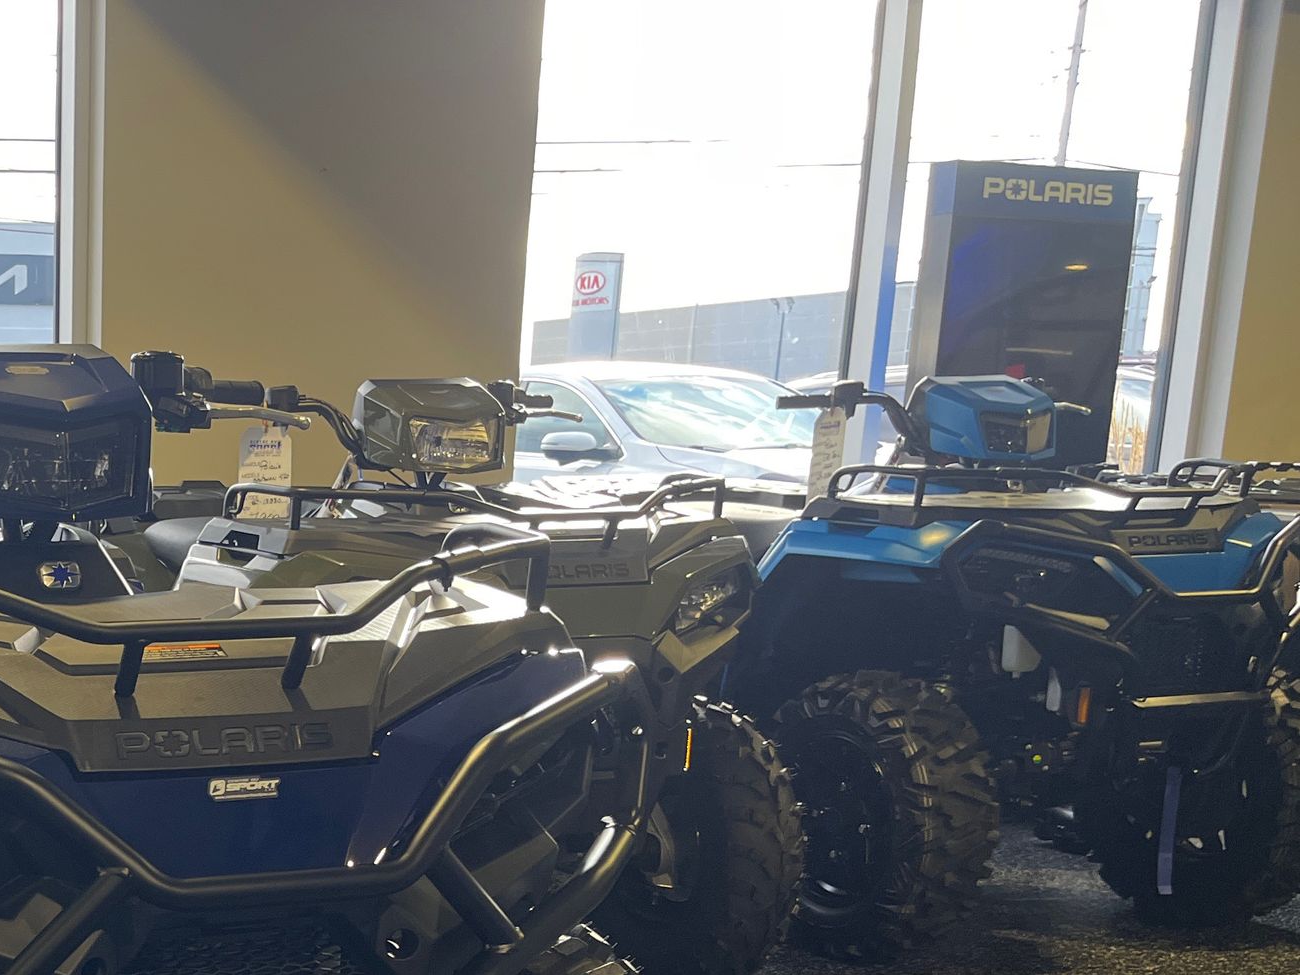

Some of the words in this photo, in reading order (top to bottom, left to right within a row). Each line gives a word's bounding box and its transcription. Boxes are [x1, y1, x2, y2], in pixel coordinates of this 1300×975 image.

[982, 177, 1113, 206] POLARIS
[580, 274, 600, 290] KIA
[1128, 534, 1209, 548] POLARIS
[548, 563, 630, 580] OLARIS
[116, 722, 334, 760] POLARIS
[226, 780, 280, 792] SPORT
